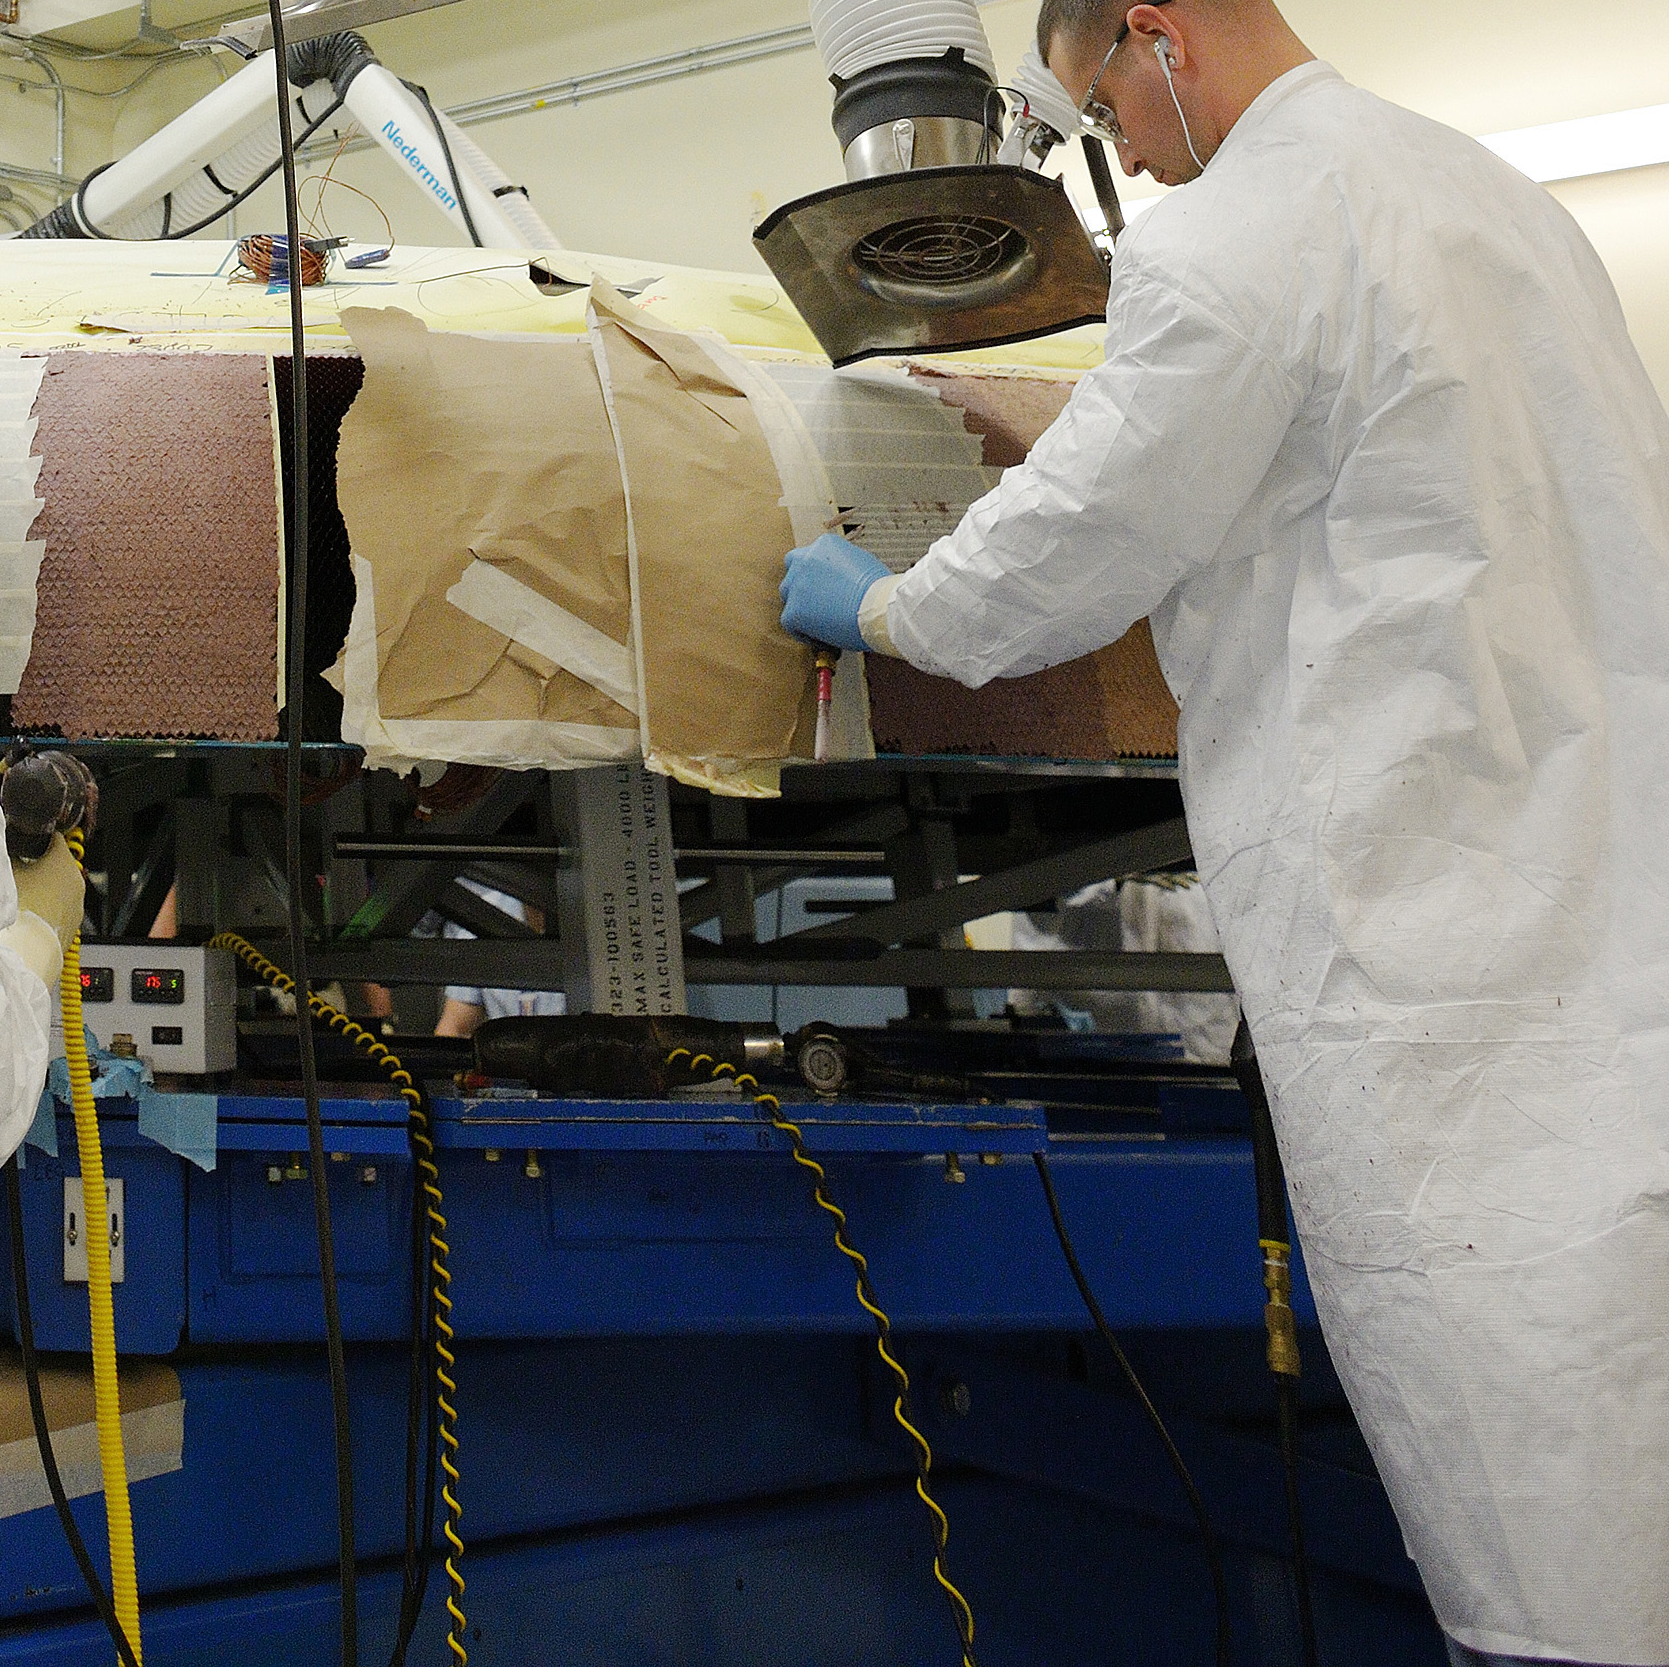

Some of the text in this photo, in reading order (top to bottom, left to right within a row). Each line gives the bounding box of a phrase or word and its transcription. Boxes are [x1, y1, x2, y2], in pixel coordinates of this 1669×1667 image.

[381, 120, 456, 210] Nederman
[625, 859, 640, 909] LOAD
[641, 770, 672, 1013] CALCULATED TOOL WEIGH
